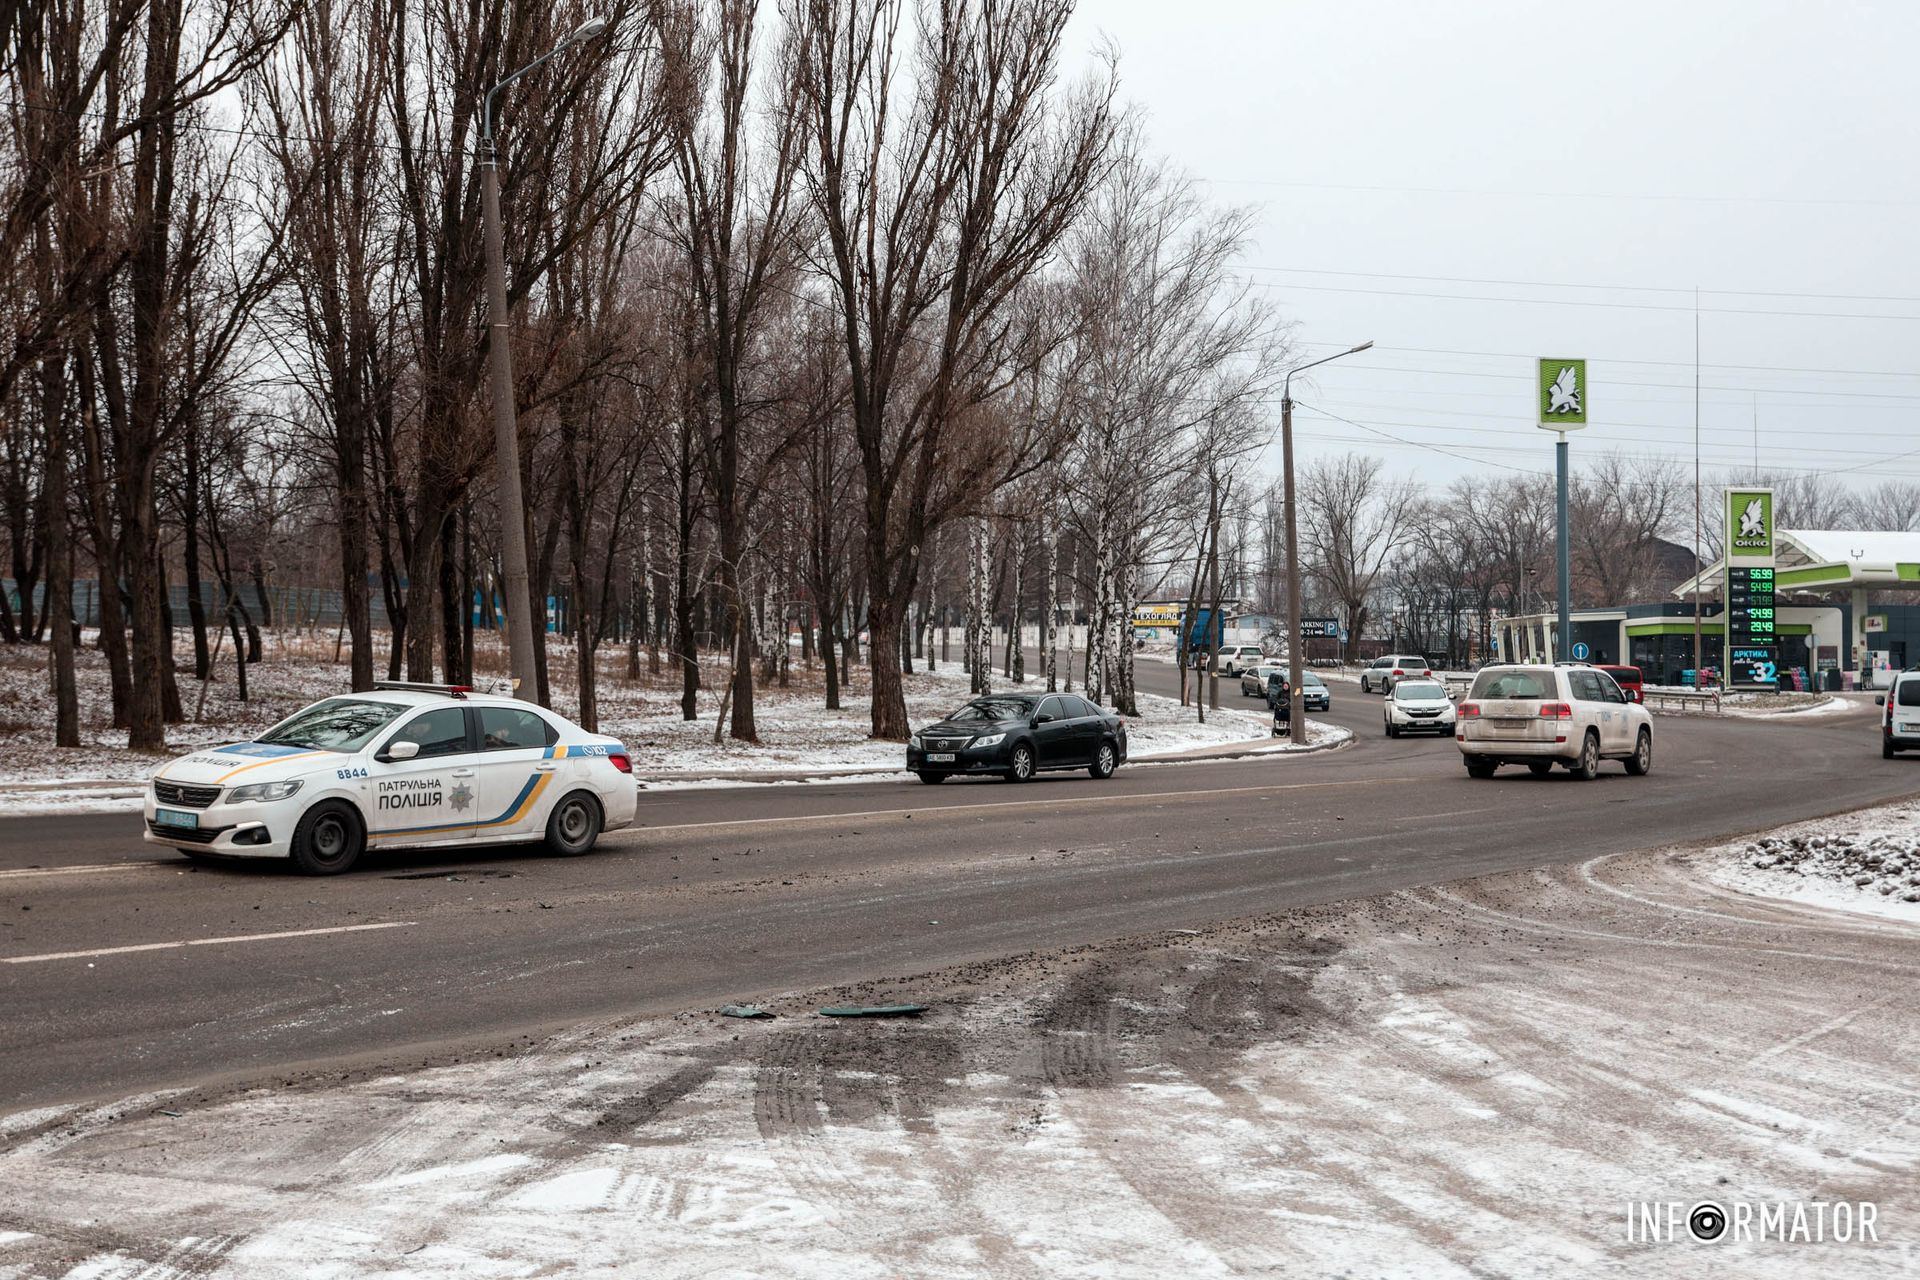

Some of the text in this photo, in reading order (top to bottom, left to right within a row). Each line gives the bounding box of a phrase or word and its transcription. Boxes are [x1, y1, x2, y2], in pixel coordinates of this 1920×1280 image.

[1750, 569, 1773, 579] 56.99
[1750, 582, 1773, 592] 54.99
[1750, 608, 1773, 618] 54.99
[1750, 621, 1773, 632] 29.49
[1733, 650, 1769, 658] АРКТИКА
[592, 745, 608, 755] 102
[337, 768, 368, 779] 8844
[379, 779, 442, 792] ПАТРУЛЬНА
[379, 792, 442, 810] ПОЛІЦІЯ
